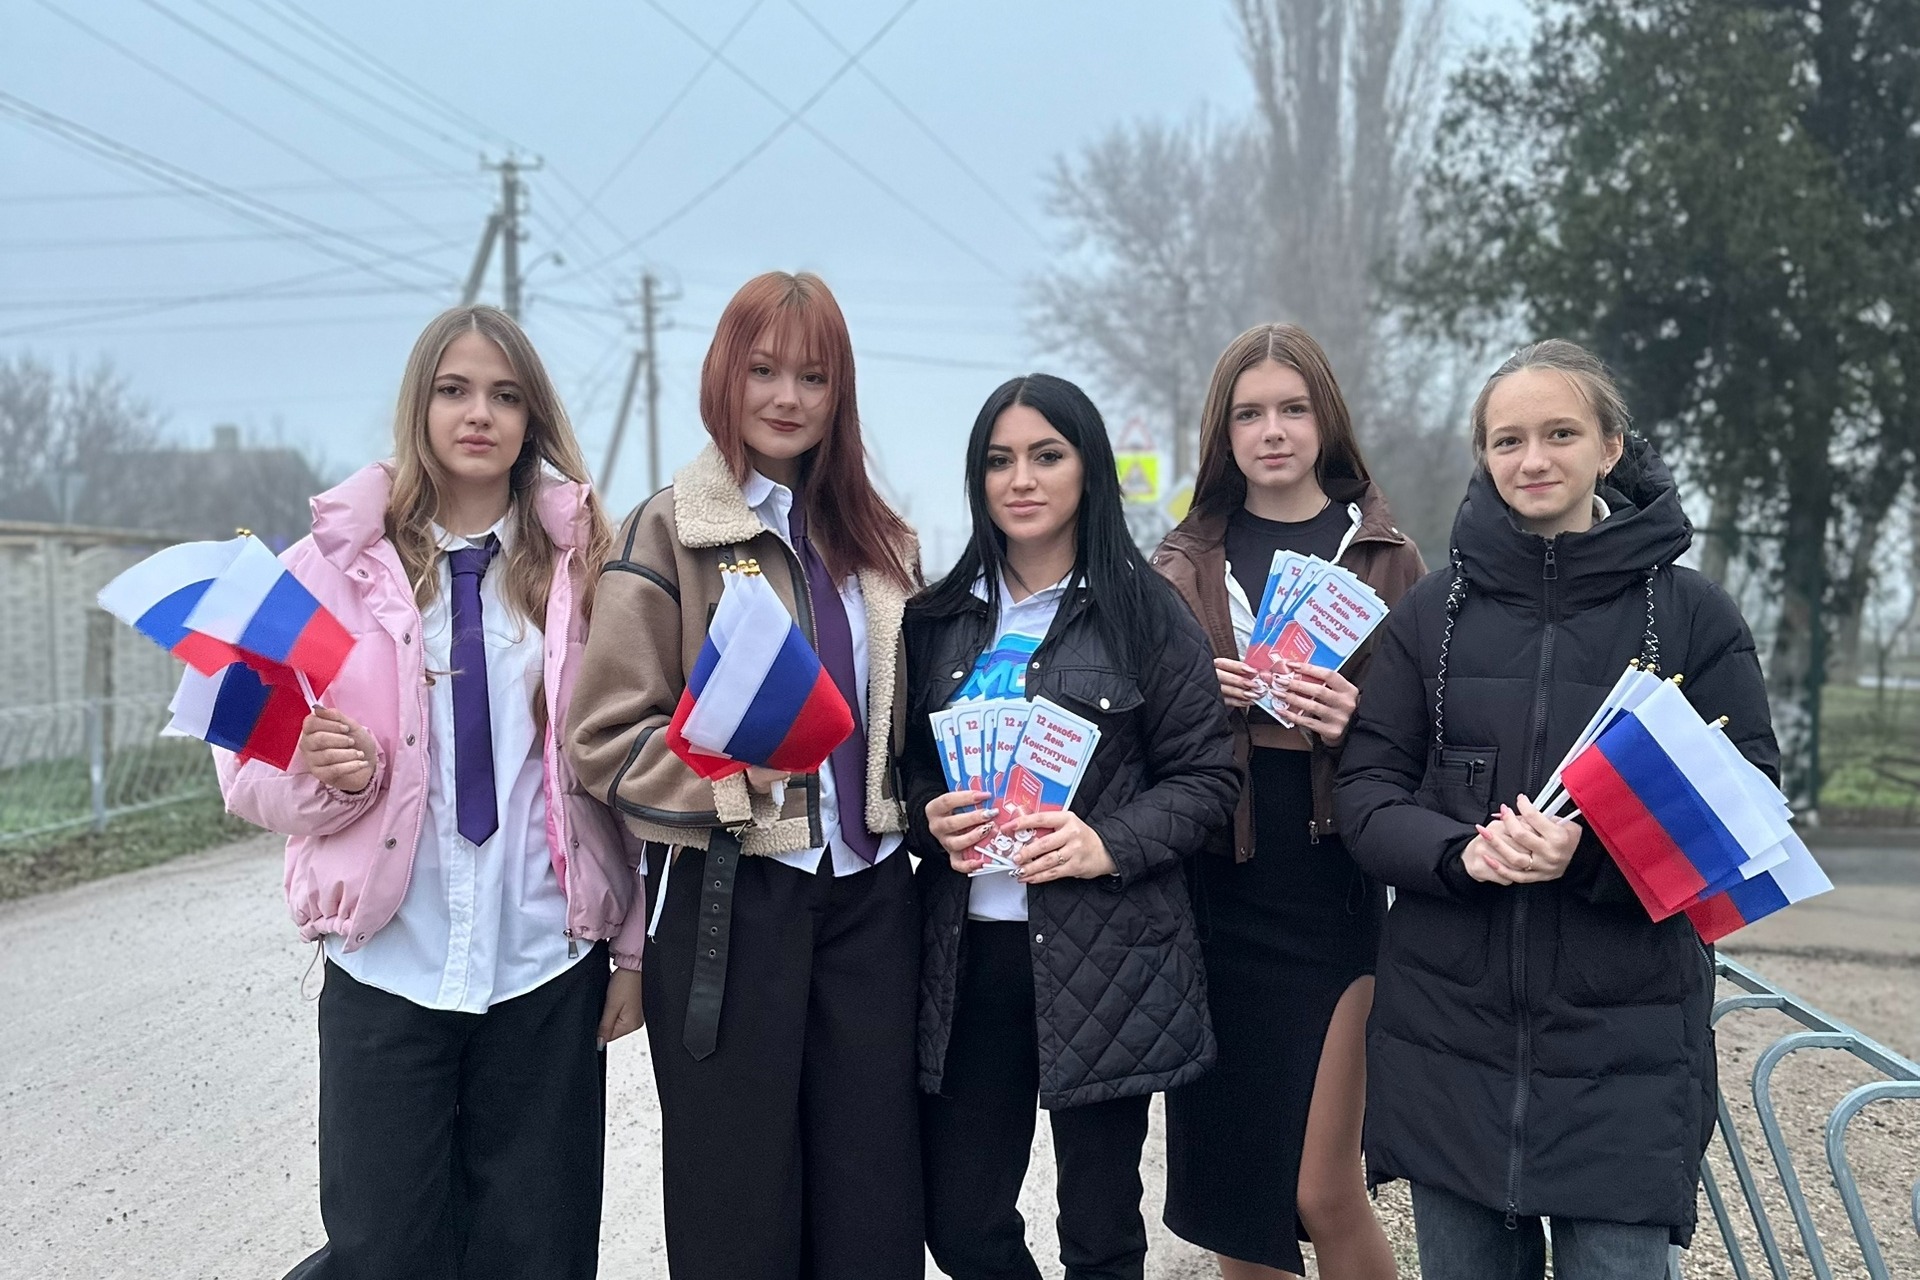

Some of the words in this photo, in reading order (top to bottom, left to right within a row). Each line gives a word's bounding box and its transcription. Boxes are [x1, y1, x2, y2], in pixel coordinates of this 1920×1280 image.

[1326, 582, 1338, 595] 12
[1336, 593, 1371, 621] декабря
[1329, 601, 1350, 621] День
[1306, 596, 1360, 642] Конституции
[1310, 614, 1341, 642] России
[966, 720, 979, 730] 12
[1005, 717, 1015, 727] 12
[1036, 714, 1047, 727] 12
[1047, 722, 1082, 743] декабря
[1022, 734, 1078, 768] Конституции
[1043, 732, 1065, 748] День
[1030, 751, 1062, 773] России
